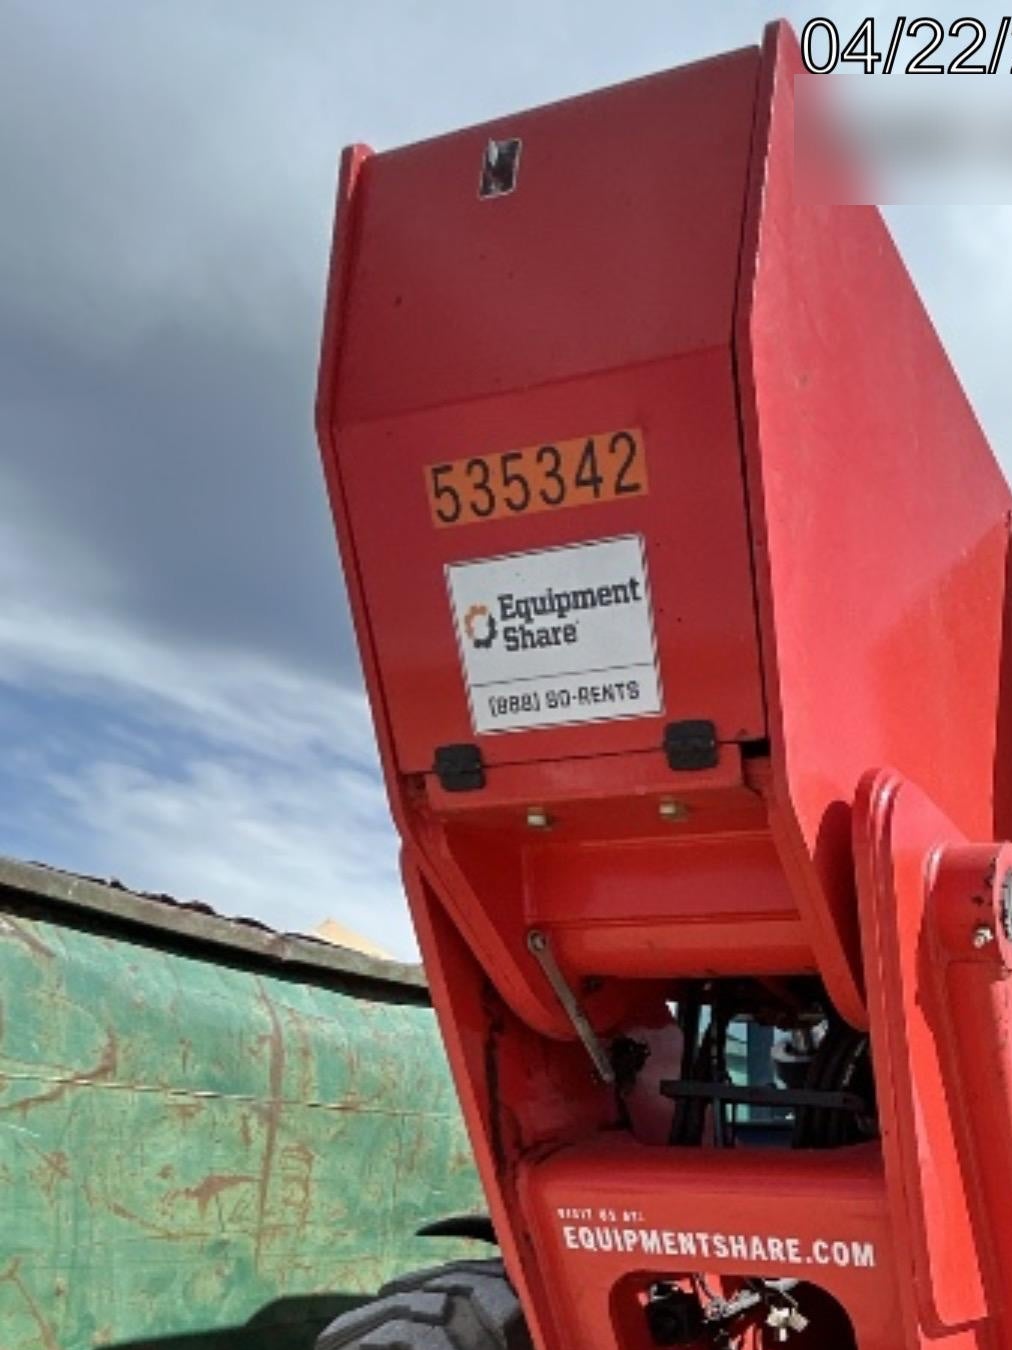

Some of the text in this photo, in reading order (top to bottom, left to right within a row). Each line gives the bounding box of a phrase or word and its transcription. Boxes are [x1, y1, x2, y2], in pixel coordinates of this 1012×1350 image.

[431, 431, 642, 523] 535342
[497, 576, 642, 623] Equipment
[502, 624, 578, 651] Share
[562, 1226, 876, 1267] EQUIPMENTSHARE.COM
